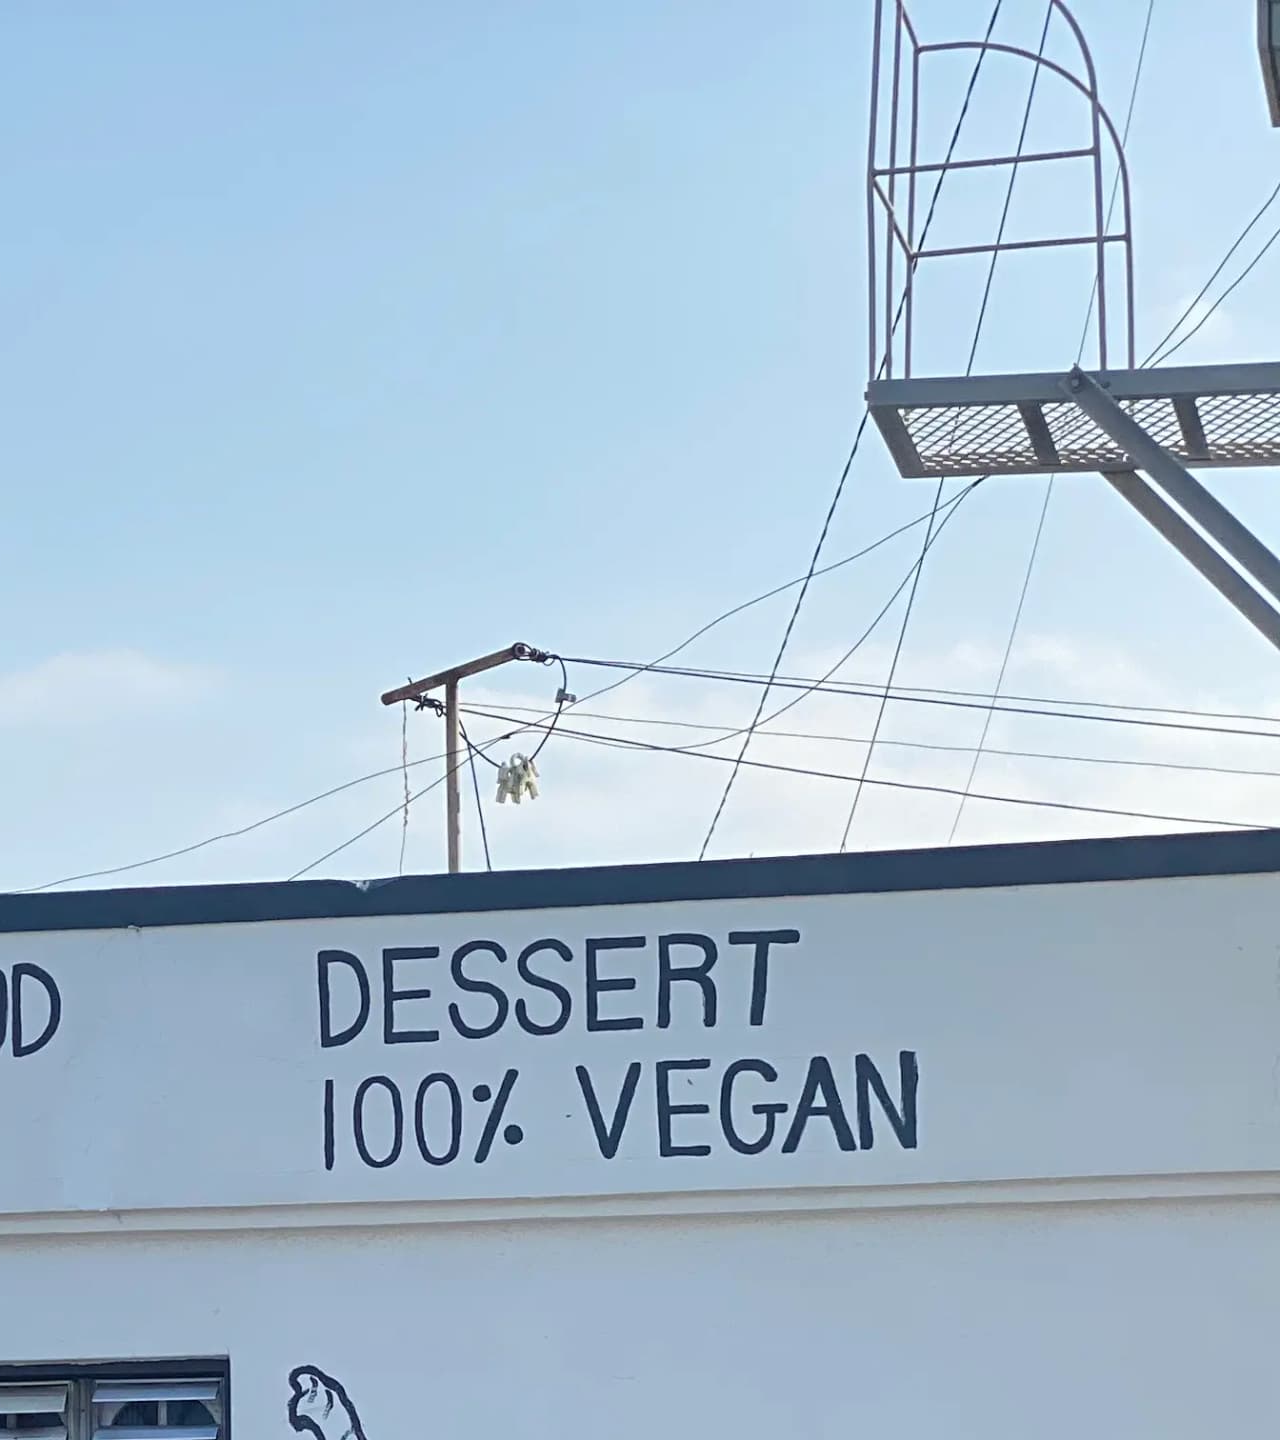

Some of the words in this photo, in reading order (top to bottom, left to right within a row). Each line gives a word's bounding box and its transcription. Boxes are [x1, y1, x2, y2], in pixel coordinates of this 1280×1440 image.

[318, 929, 800, 1048] DESSERT
[324, 1069, 523, 1170] 100%
[576, 1051, 918, 1159] VEGAN
